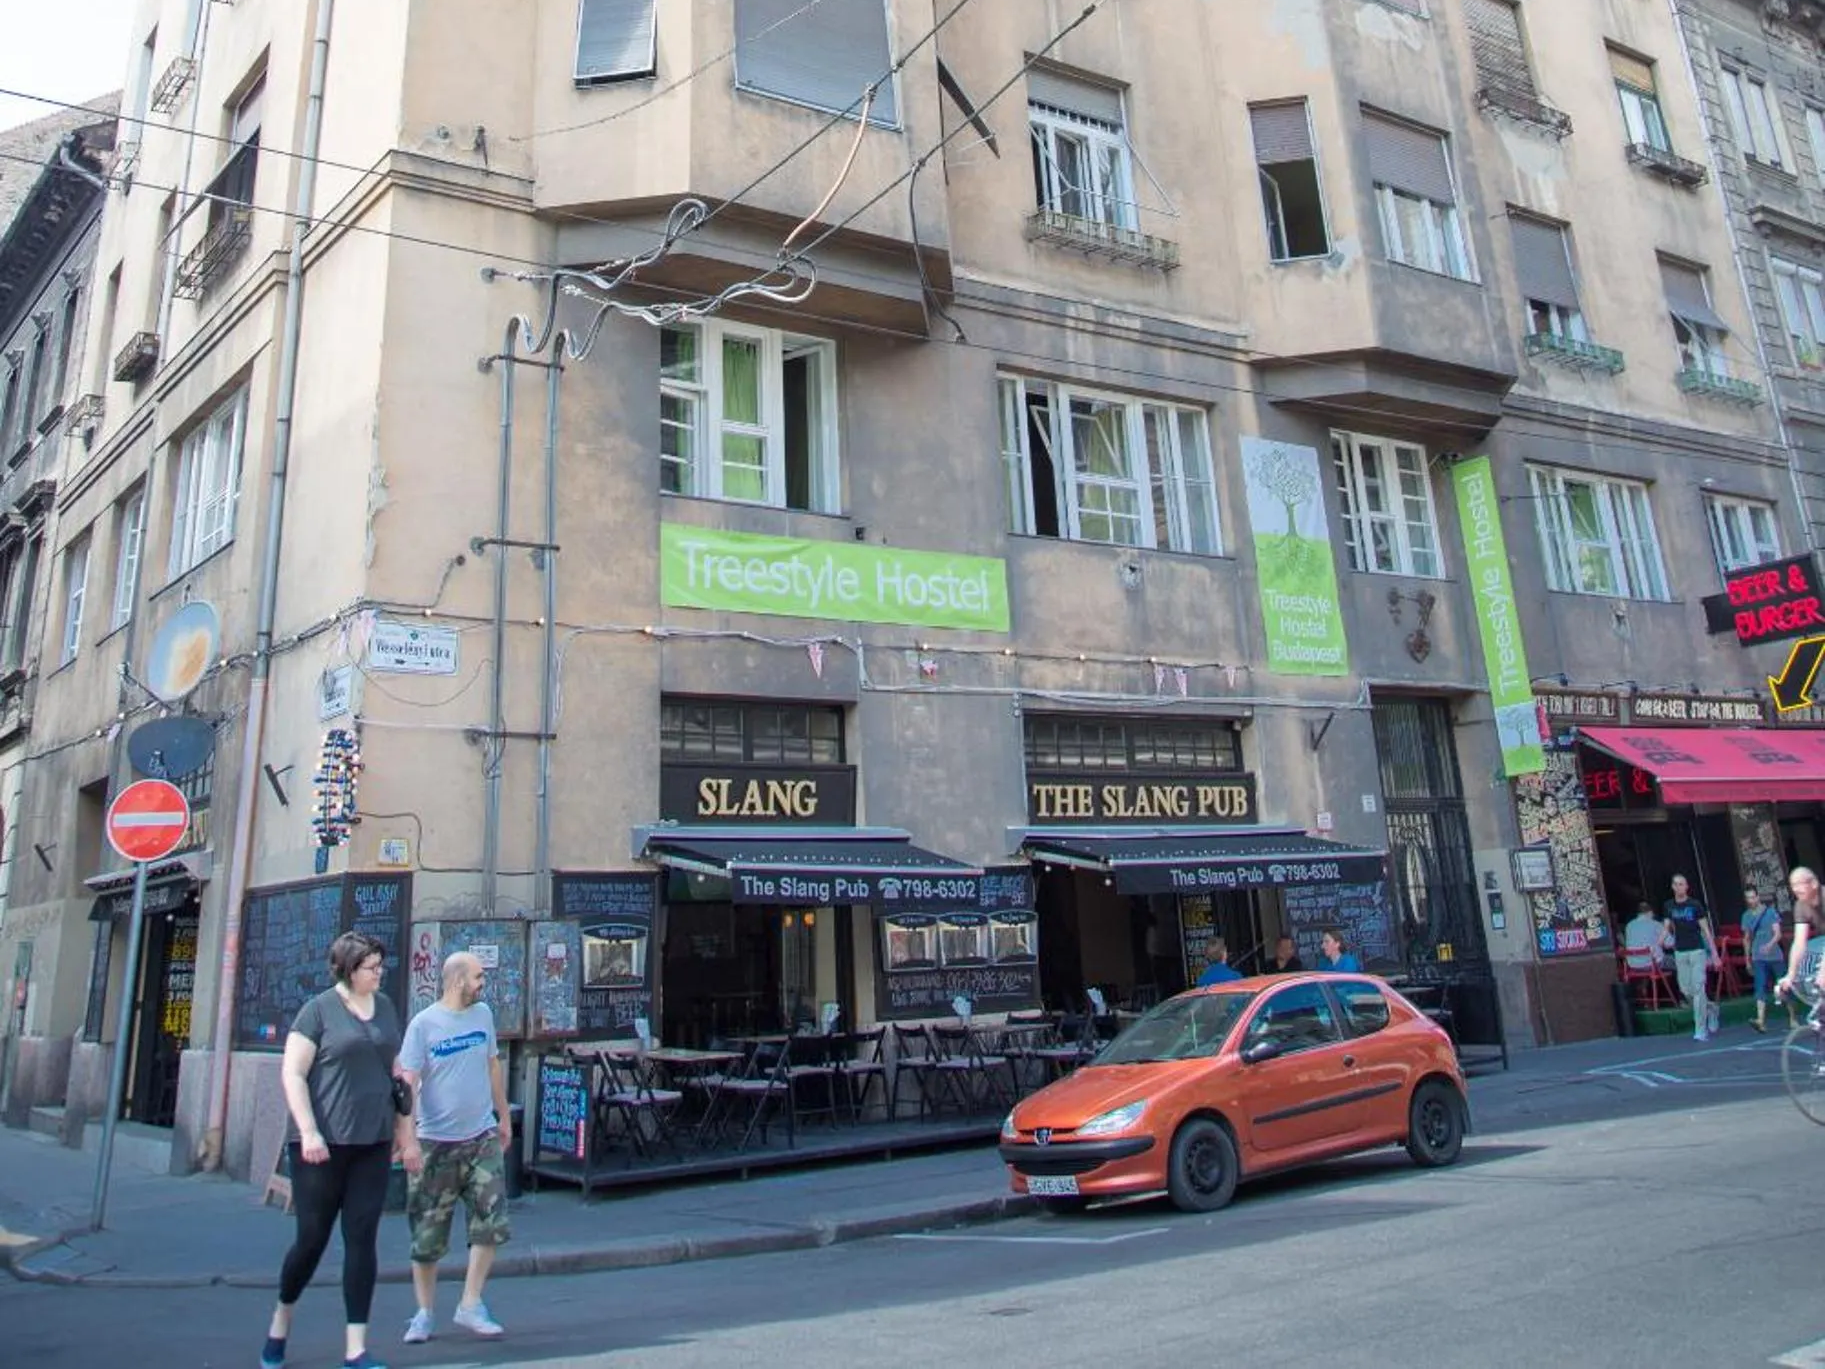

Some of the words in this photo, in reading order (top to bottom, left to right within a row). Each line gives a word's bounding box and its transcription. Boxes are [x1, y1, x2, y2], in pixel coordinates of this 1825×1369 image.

[1461, 472, 1496, 560] Hostel
[679, 539, 860, 609] Treestyle
[876, 560, 991, 615] Hostel
[1727, 570, 1787, 607] BEER
[1788, 563, 1809, 593] &
[1264, 588, 1332, 618] Treestyle
[1734, 596, 1825, 640] BURGER
[1280, 616, 1327, 638] Hostel
[1480, 566, 1519, 697] Treestyle
[1273, 639, 1343, 667] Budapest
[697, 778, 818, 817] SLANG
[1033, 783, 1094, 818] THE
[1102, 784, 1189, 818] SLANG
[1198, 785, 1249, 818] PUB
[740, 875, 774, 896] The
[780, 877, 830, 902] Slang
[834, 879, 869, 898] Pub
[903, 878, 976, 899] 798-6302
[1170, 868, 1197, 886] The
[1199, 866, 1237, 887] Slang
[1239, 866, 1264, 883] Pub
